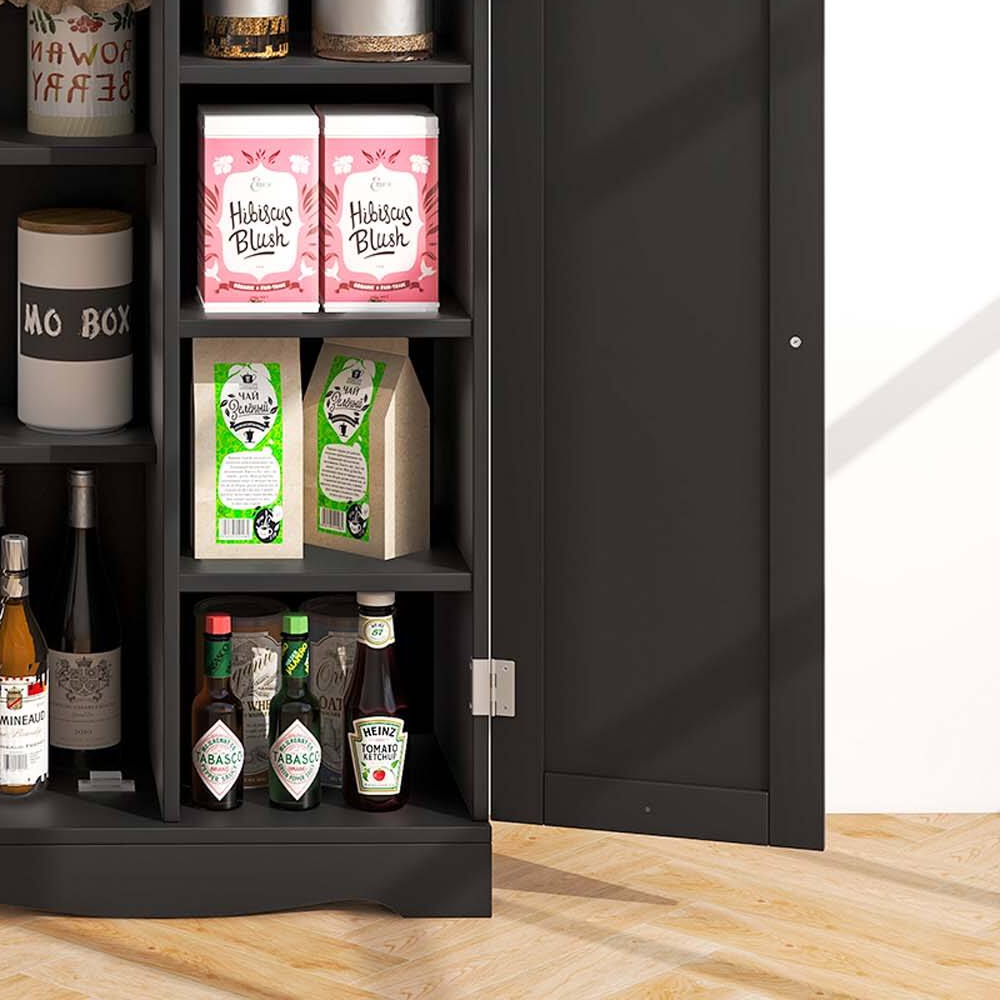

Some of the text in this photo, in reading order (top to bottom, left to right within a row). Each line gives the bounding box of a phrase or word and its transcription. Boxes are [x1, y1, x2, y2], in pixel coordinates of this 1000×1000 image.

[230, 200, 293, 230] Hibiscus
[350, 200, 413, 230] Hibiscus
[229, 226, 290, 255] Blush
[349, 226, 410, 255] Blush
[24, 303, 130, 340] MO BOX
[238, 391, 259, 400] ЧАЙ
[343, 386, 360, 396] ЧАЙ
[362, 725, 397, 737] HEINZ
[361, 743, 399, 753] TOMATO
[196, 750, 242, 766] TABASCO
[274, 750, 320, 766] TABASCO
[363, 753, 397, 761] KETCHUP
